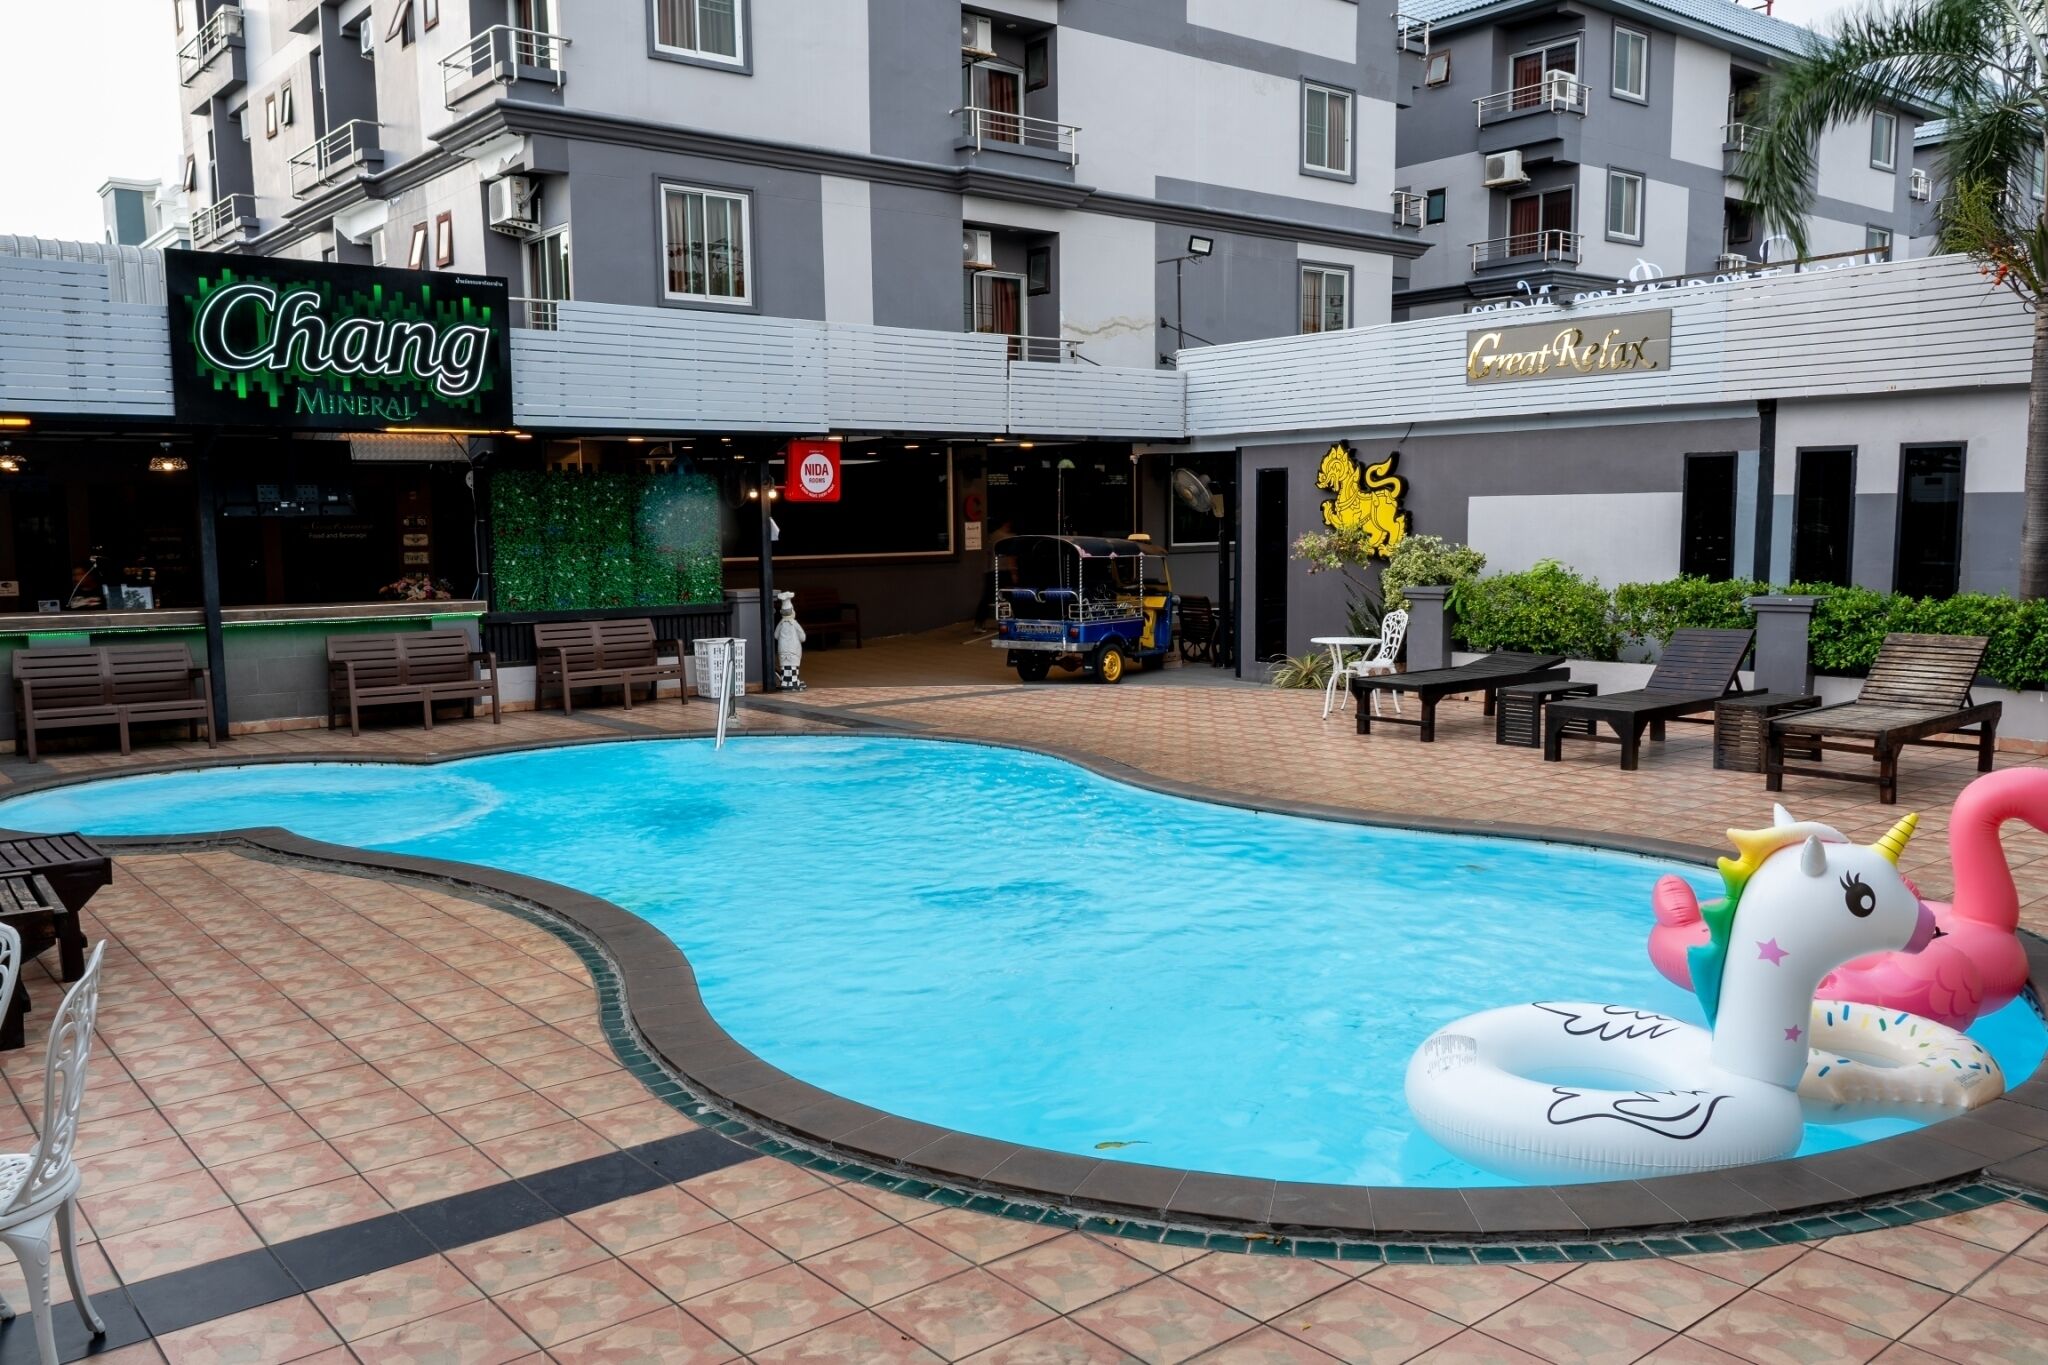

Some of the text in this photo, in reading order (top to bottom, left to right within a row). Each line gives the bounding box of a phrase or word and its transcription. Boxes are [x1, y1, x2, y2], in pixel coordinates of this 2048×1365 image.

[198, 283, 490, 397] Chang
[1467, 327, 1657, 379] Great Relax
[295, 387, 418, 421] MINERAL
[804, 463, 829, 476] NIDA
